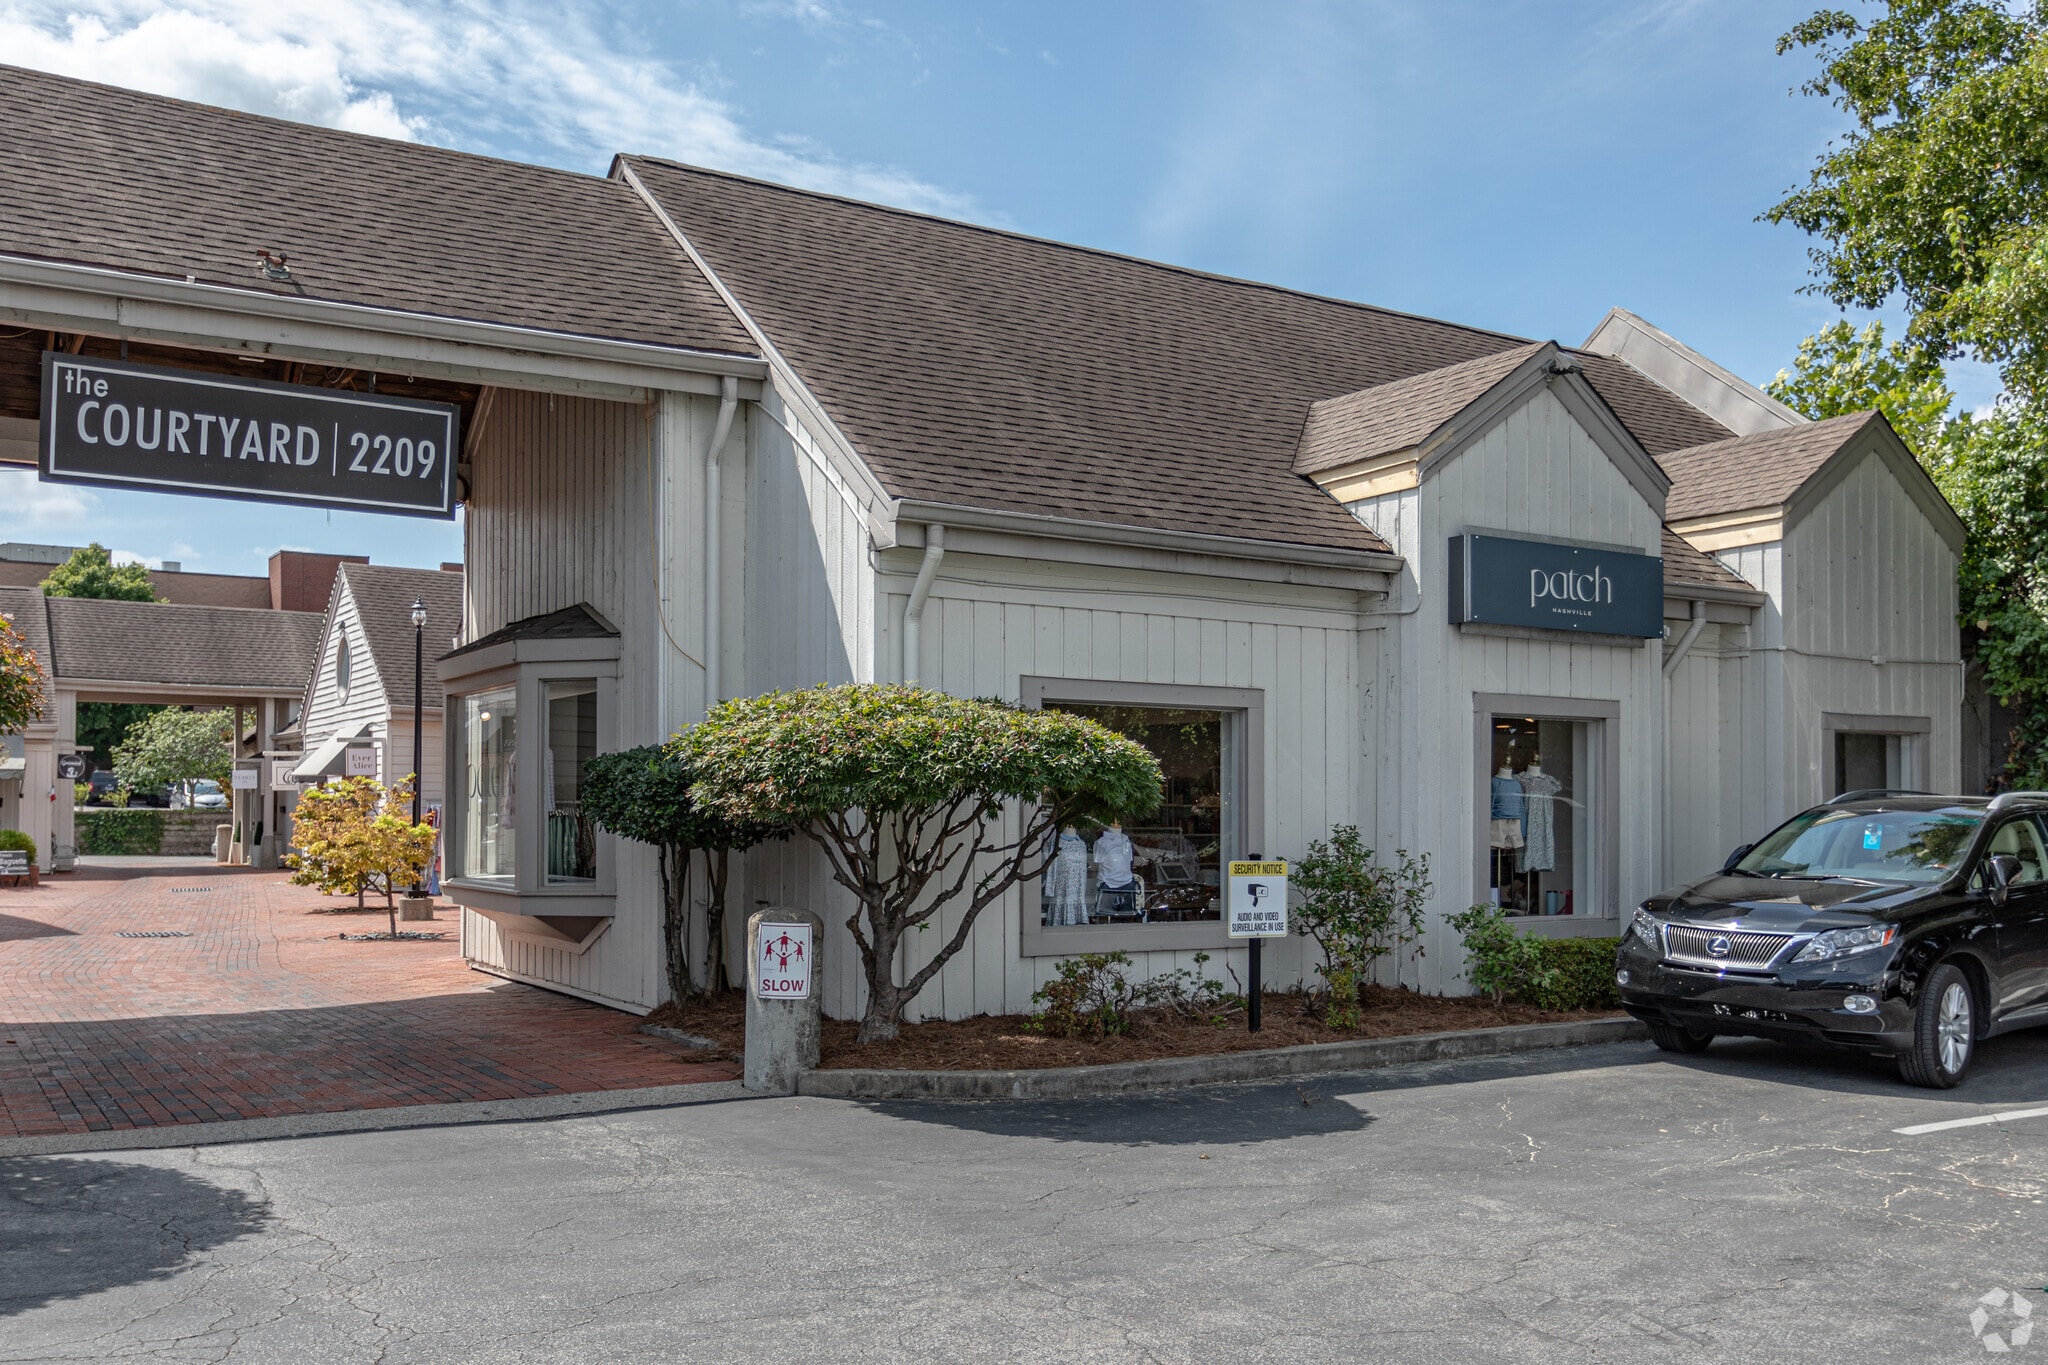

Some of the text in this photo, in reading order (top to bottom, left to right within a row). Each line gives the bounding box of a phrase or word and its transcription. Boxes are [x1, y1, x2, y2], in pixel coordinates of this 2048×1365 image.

[64, 368, 109, 397] the
[76, 400, 437, 479] COURTYARD 2209
[1530, 565, 1612, 608] patch
[1552, 608, 1592, 616] NASHVILLE
[352, 754, 372, 762] Ever
[1234, 864, 1282, 874] SECURITY NOTICE
[1238, 912, 1279, 921] AUDIO AND VIDEO
[1232, 922, 1284, 932] SURVEILLANCE IN USE
[762, 979, 804, 992] SLOW
